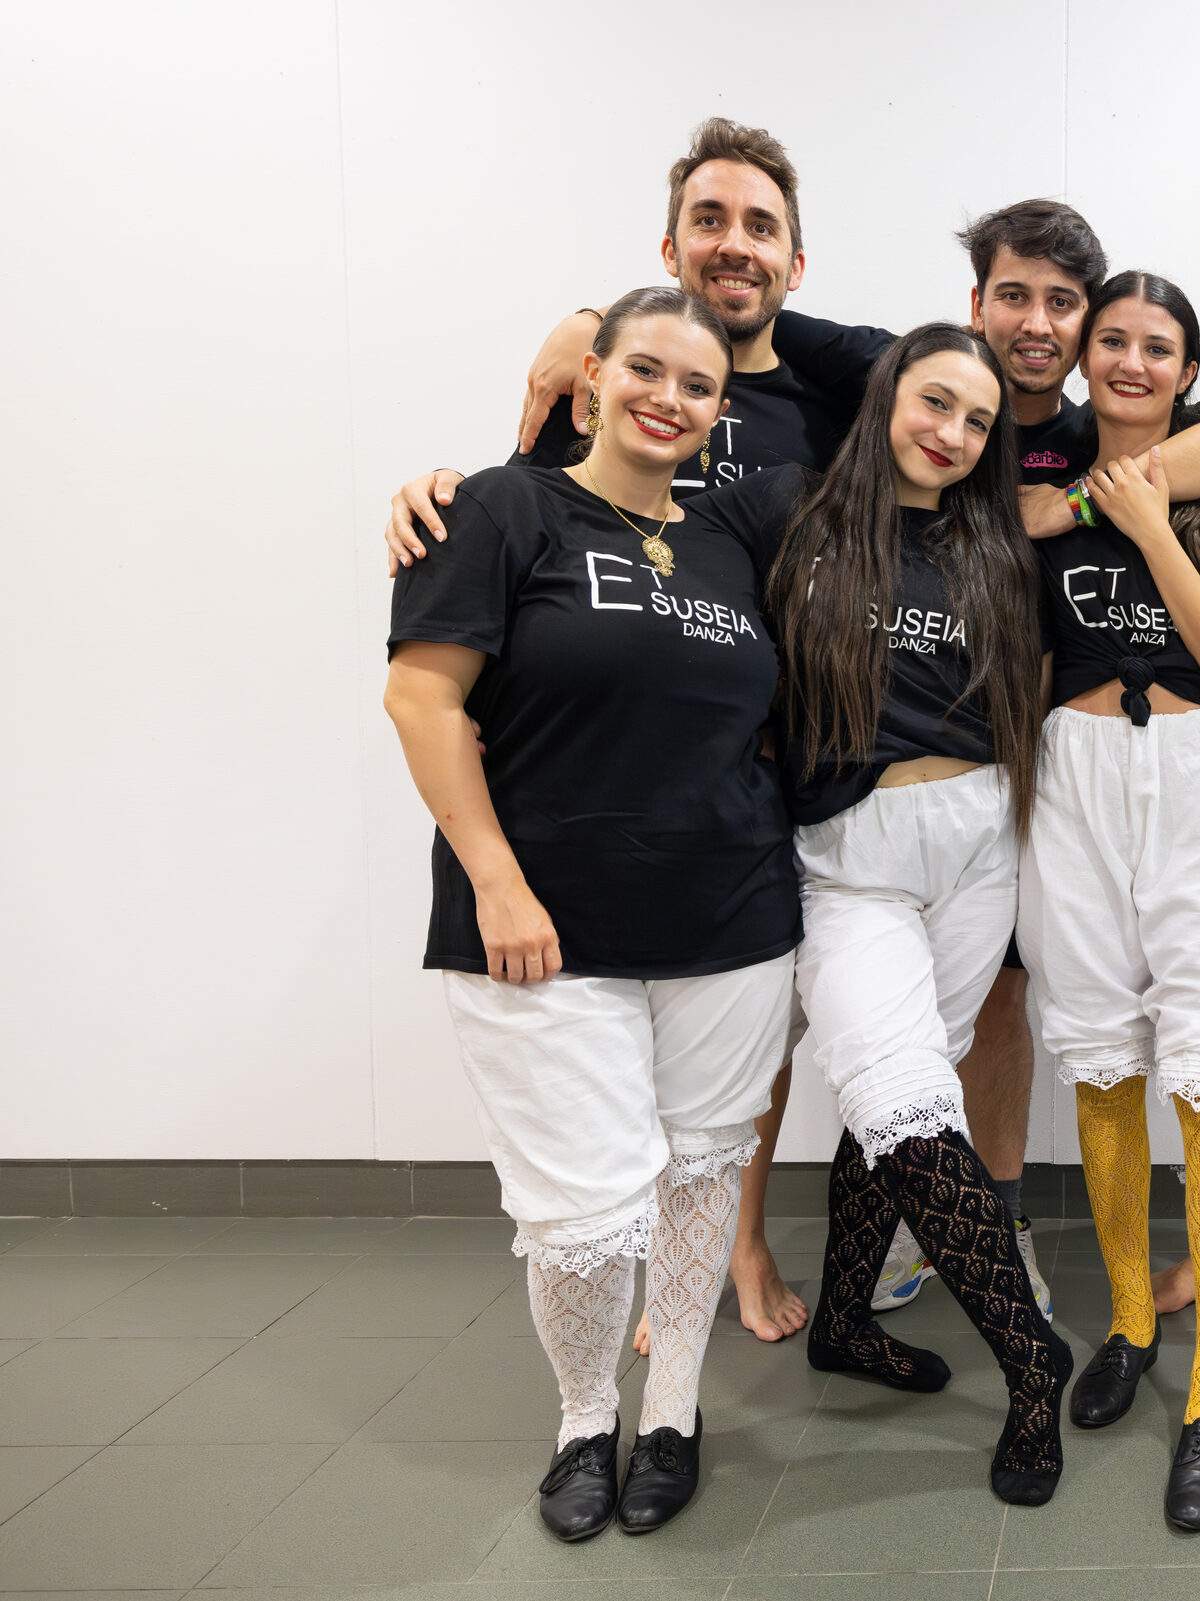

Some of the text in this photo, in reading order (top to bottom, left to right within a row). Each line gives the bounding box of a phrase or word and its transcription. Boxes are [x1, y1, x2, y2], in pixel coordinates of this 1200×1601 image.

[586, 551, 664, 612] ET
[1063, 565, 1127, 629] ET
[651, 591, 758, 640] SUSEIA
[1107, 603, 1178, 632] SUSE
[683, 622, 736, 646] DANZA
[888, 636, 936, 655] DANZA
[1130, 632, 1166, 646] ANZA
